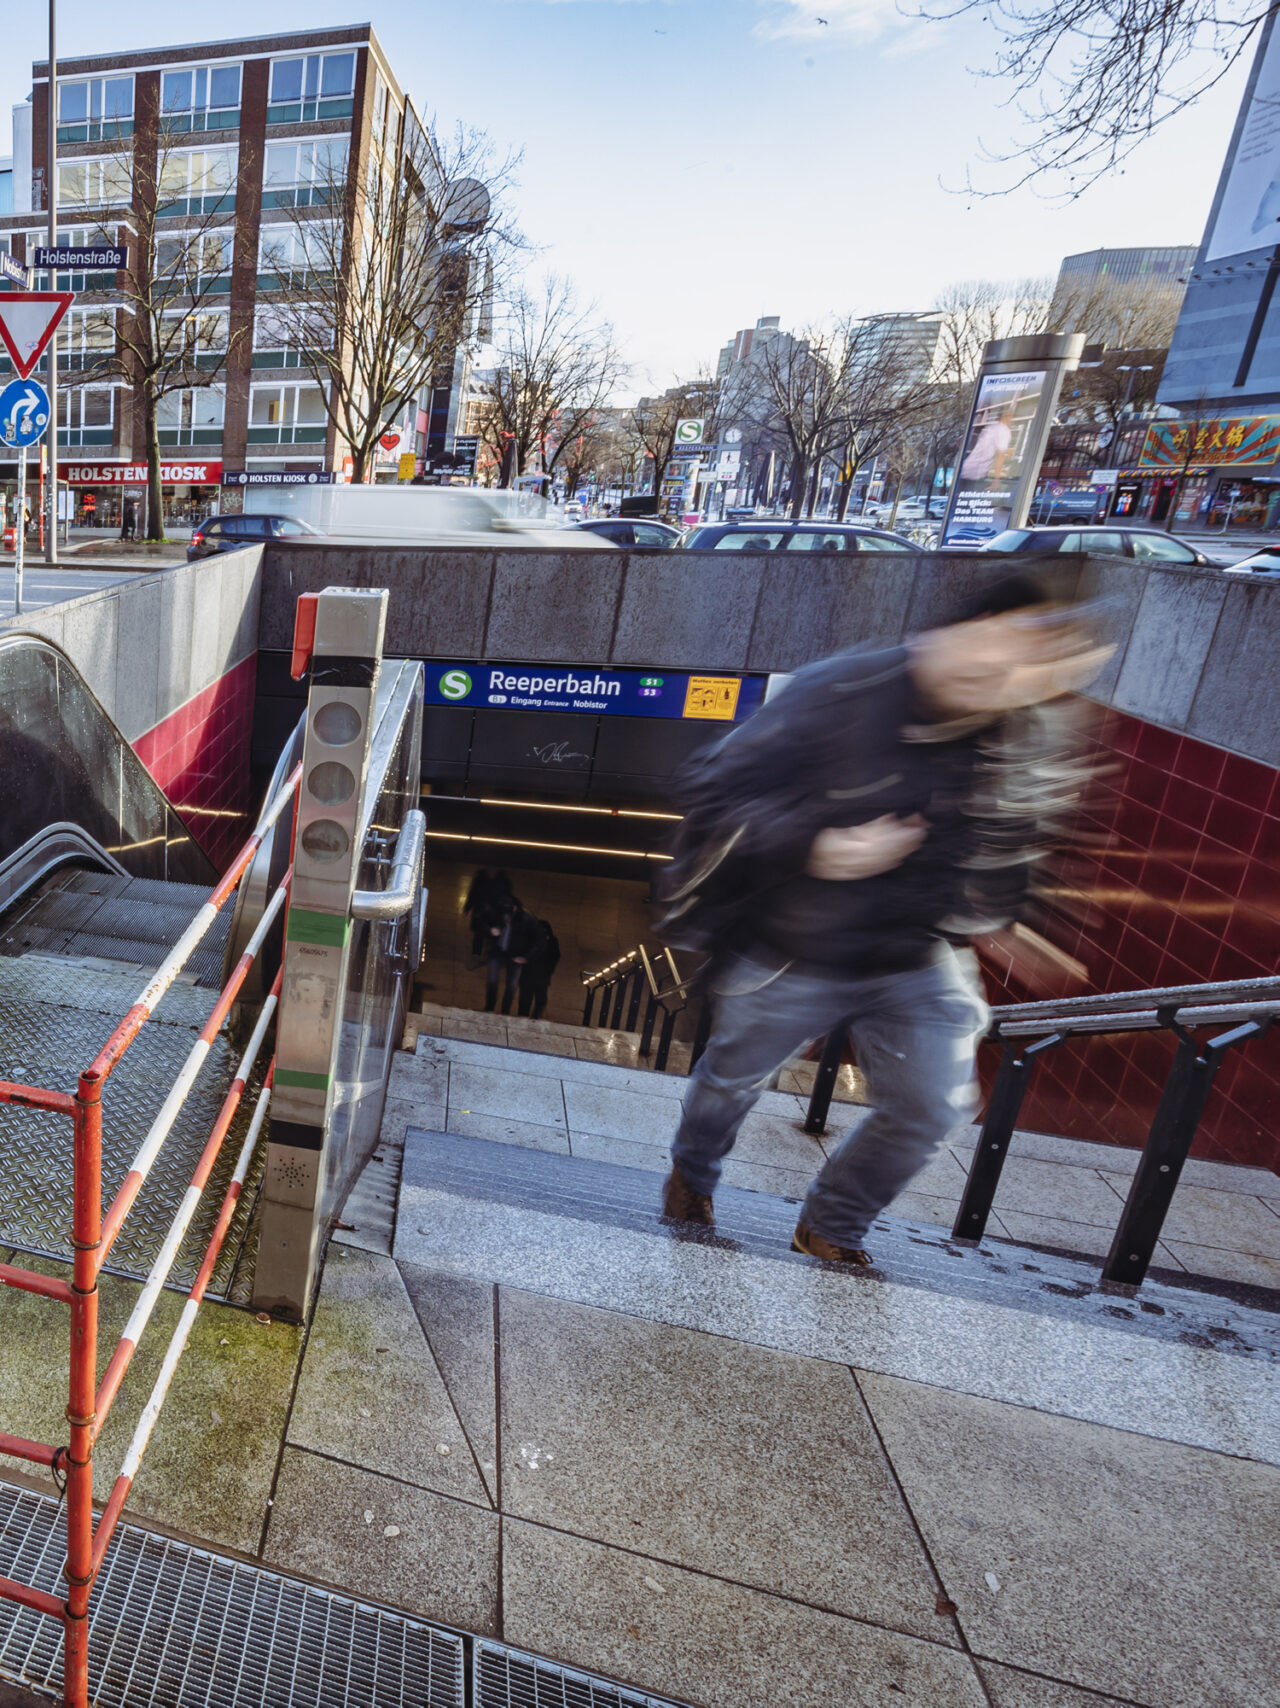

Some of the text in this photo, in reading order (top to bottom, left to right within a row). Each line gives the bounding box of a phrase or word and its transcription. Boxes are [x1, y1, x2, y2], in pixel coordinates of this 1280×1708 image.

[40, 250, 121, 264] Holstenstraße
[67, 466, 148, 481] HOLSTEN
[249, 474, 306, 482] HOLSTEN KIOSK
[489, 671, 621, 696] Reeperbahn
[646, 678, 658, 686] S1
[643, 688, 657, 696] S3
[510, 696, 542, 706] Eingang
[543, 699, 569, 707] Entrance
[573, 699, 608, 709] Nobistor
